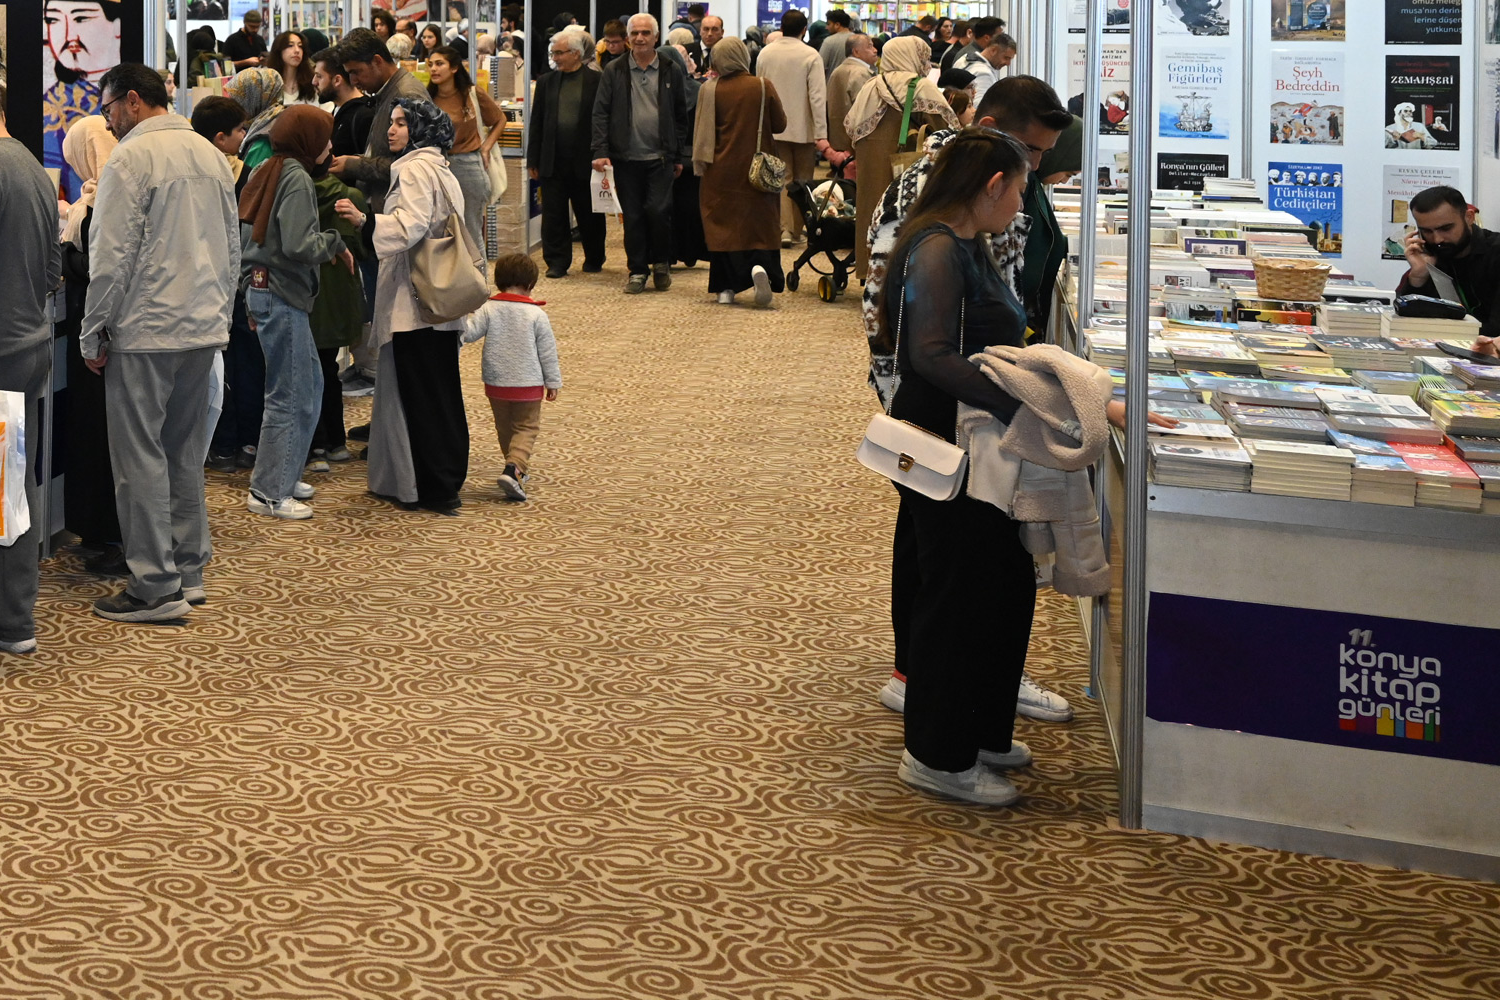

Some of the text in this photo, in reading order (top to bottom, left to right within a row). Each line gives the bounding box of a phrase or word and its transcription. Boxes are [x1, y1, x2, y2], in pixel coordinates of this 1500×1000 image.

[1101, 66, 1114, 77] İZ
[1168, 63, 1223, 75] Gemibaş
[1293, 66, 1323, 81] Şeyh
[1169, 73, 1222, 84] Figürleri
[1391, 75, 1454, 86] ZEMAHŞERİ
[1276, 79, 1340, 92] Bedreddin
[1160, 162, 1225, 172] Konya'nın Gülleri
[1274, 187, 1336, 199] Türkistan
[1274, 198, 1336, 211] Ceditçileri
[1348, 628, 1377, 648] 11.
[1339, 643, 1441, 678] konya
[1339, 666, 1441, 707] kitap
[1339, 698, 1441, 726] günleri
